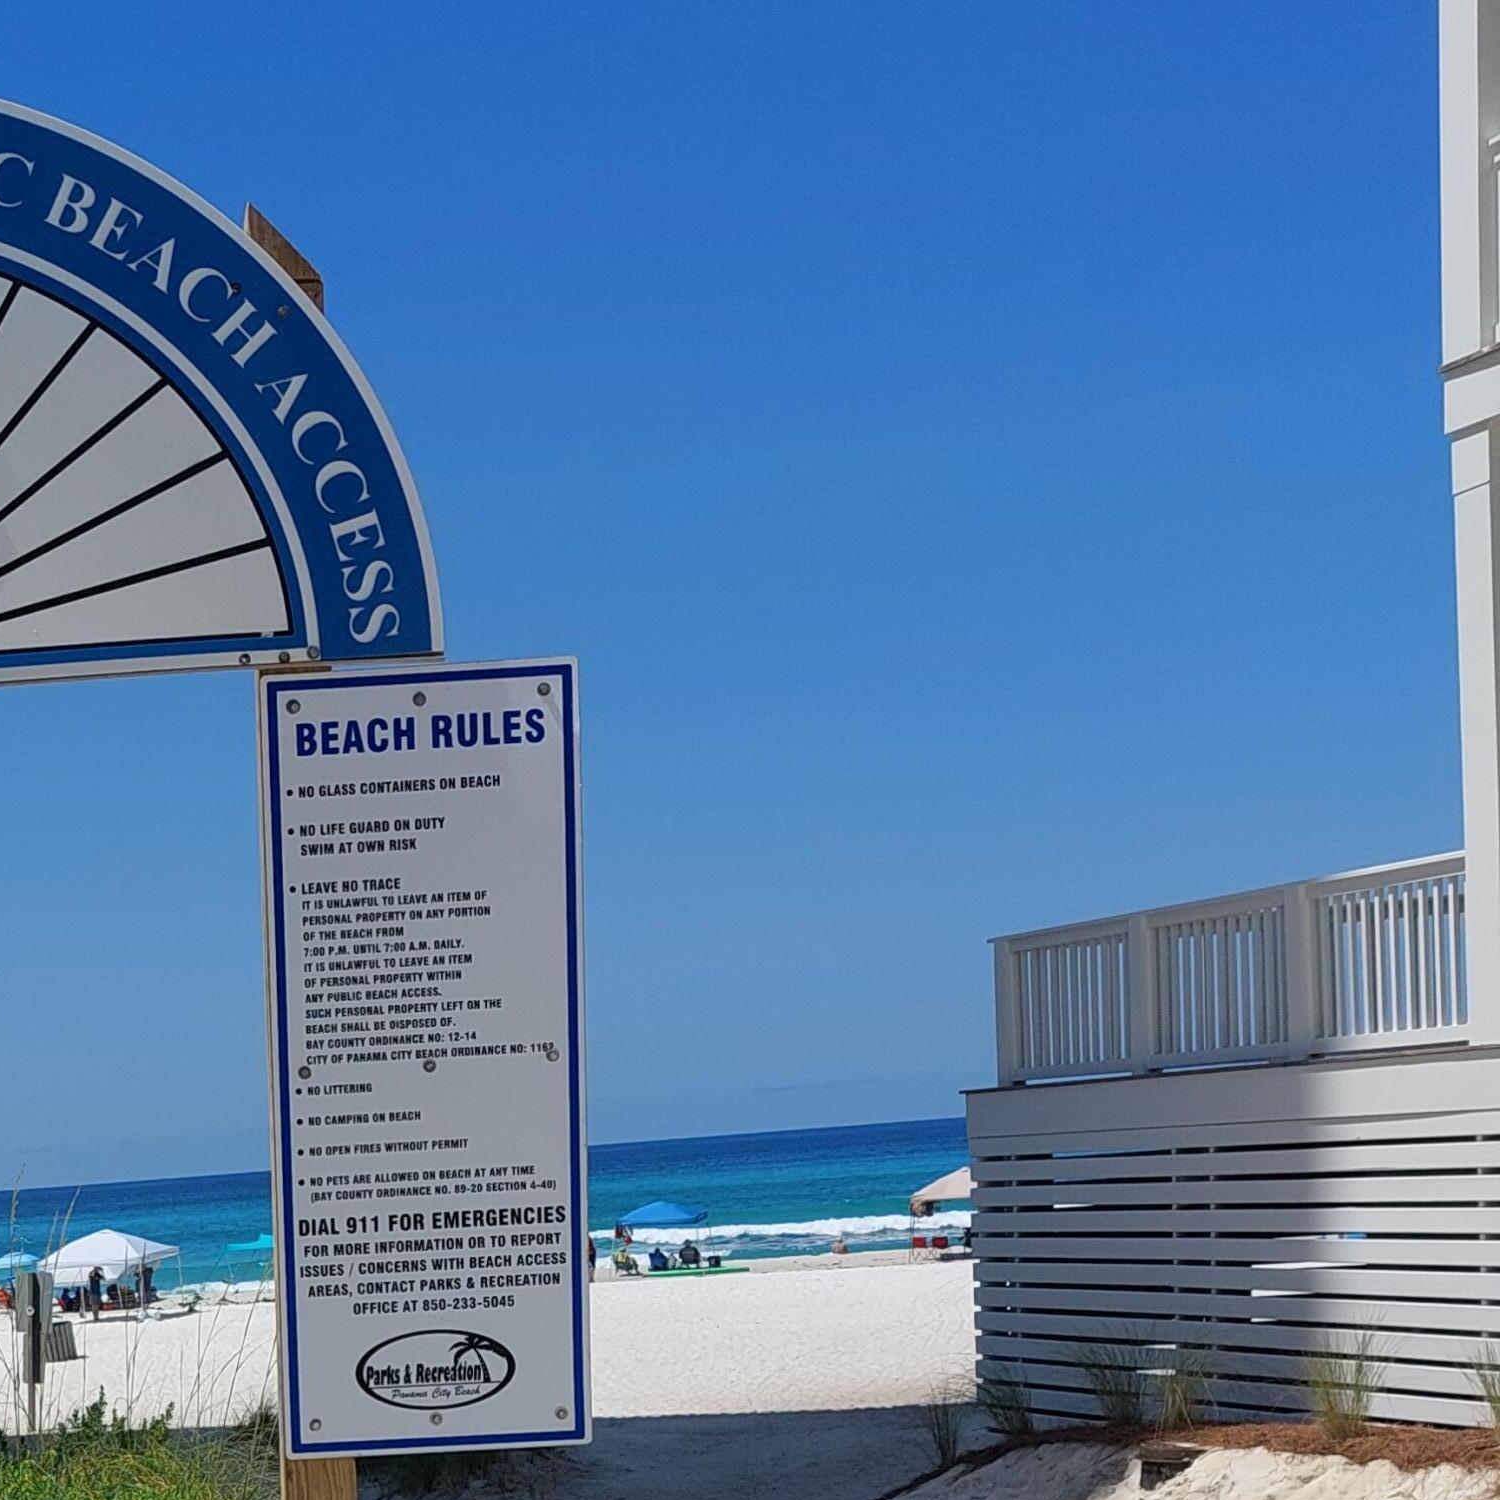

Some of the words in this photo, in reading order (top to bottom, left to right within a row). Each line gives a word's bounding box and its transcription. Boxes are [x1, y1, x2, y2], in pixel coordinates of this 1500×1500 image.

[43, 174, 278, 368] BEACH
[254, 373, 400, 643] ACCESS
[295, 716, 415, 756] BEACH
[431, 708, 545, 748] RULES
[298, 785, 314, 798] NO
[318, 783, 355, 796] GLASS
[360, 778, 435, 794] CONTAINERS
[439, 777, 455, 789] ON
[460, 774, 500, 788] BEACH
[299, 824, 315, 836] NO
[319, 822, 345, 835] LIFE
[348, 820, 389, 833] GUARD
[393, 818, 410, 831] ON
[414, 816, 445, 830] DUTY
[300, 842, 334, 856] SWIM
[338, 841, 352, 854] AT
[356, 839, 384, 853] OWN
[389, 837, 416, 850] RISK
[301, 881, 337, 894] LEAVE
[341, 879, 358, 892] NO
[361, 877, 400, 891] TRACE
[305, 1023, 337, 1034] BEACH
[341, 1021, 370, 1032] SHALL
[373, 1020, 385, 1030] BE
[389, 1017, 436, 1029] DISPOSED
[439, 1016, 456, 1026] OF.
[305, 1039, 324, 1049] BAY
[327, 1037, 365, 1048] COUNTY
[369, 1033, 424, 1045] ORDINANCE
[427, 1032, 444, 1042] NO:
[448, 1030, 476, 1041] 12-14
[307, 1085, 320, 1095] NO
[323, 1082, 372, 1094] LITTERING
[308, 1116, 321, 1125] NO
[324, 1113, 369, 1125] CAMPING
[372, 1112, 385, 1122] ON
[388, 1110, 420, 1121] BEACH
[309, 1146, 322, 1156] NO
[325, 1145, 350, 1155] OPEN
[353, 1143, 381, 1154] FIRES
[384, 1140, 428, 1152] WITHOUT
[431, 1138, 468, 1150] PERMIT
[309, 1176, 323, 1186] NO
[326, 1175, 349, 1185] PETS
[352, 1174, 371, 1184] ARE
[374, 1171, 419, 1183] ALLOWED
[422, 1170, 435, 1180] ON
[439, 1168, 470, 1179] BEACH
[474, 1167, 486, 1177] AT
[489, 1166, 508, 1176] ANY
[511, 1165, 535, 1175] TIME
[298, 1217, 339, 1236] DIAL
[346, 1215, 378, 1233] 911
[388, 1213, 424, 1231] FOR
[431, 1205, 565, 1229] EMERGENCIES
[303, 1244, 328, 1257] FOR
[333, 1242, 370, 1256] MORE
[374, 1237, 463, 1253] INFORMATION
[468, 1236, 485, 1248] OR
[489, 1234, 505, 1247] TO
[510, 1231, 561, 1246] REPORT
[299, 1263, 344, 1278] ISSUES
[358, 1259, 426, 1274] CONCERNS
[431, 1257, 464, 1270] WITH
[469, 1254, 511, 1268] BEACH
[516, 1251, 566, 1266] ACCESS
[308, 1283, 352, 1297] AREAS,
[356, 1279, 415, 1294] CONTACT
[419, 1277, 461, 1291] PARKS
[466, 1276, 475, 1289] &
[480, 1272, 560, 1288] RECREATION
[353, 1300, 398, 1314] OFFICE
[402, 1299, 418, 1312] AT
[422, 1294, 514, 1311] 850-233-5045
[367, 1365, 400, 1388] Parks
[404, 1364, 412, 1384] &
[416, 1360, 481, 1383] Recreation
[391, 1390, 427, 1399] Panama
[432, 1388, 451, 1399] City
[454, 1385, 480, 1396] Beach
